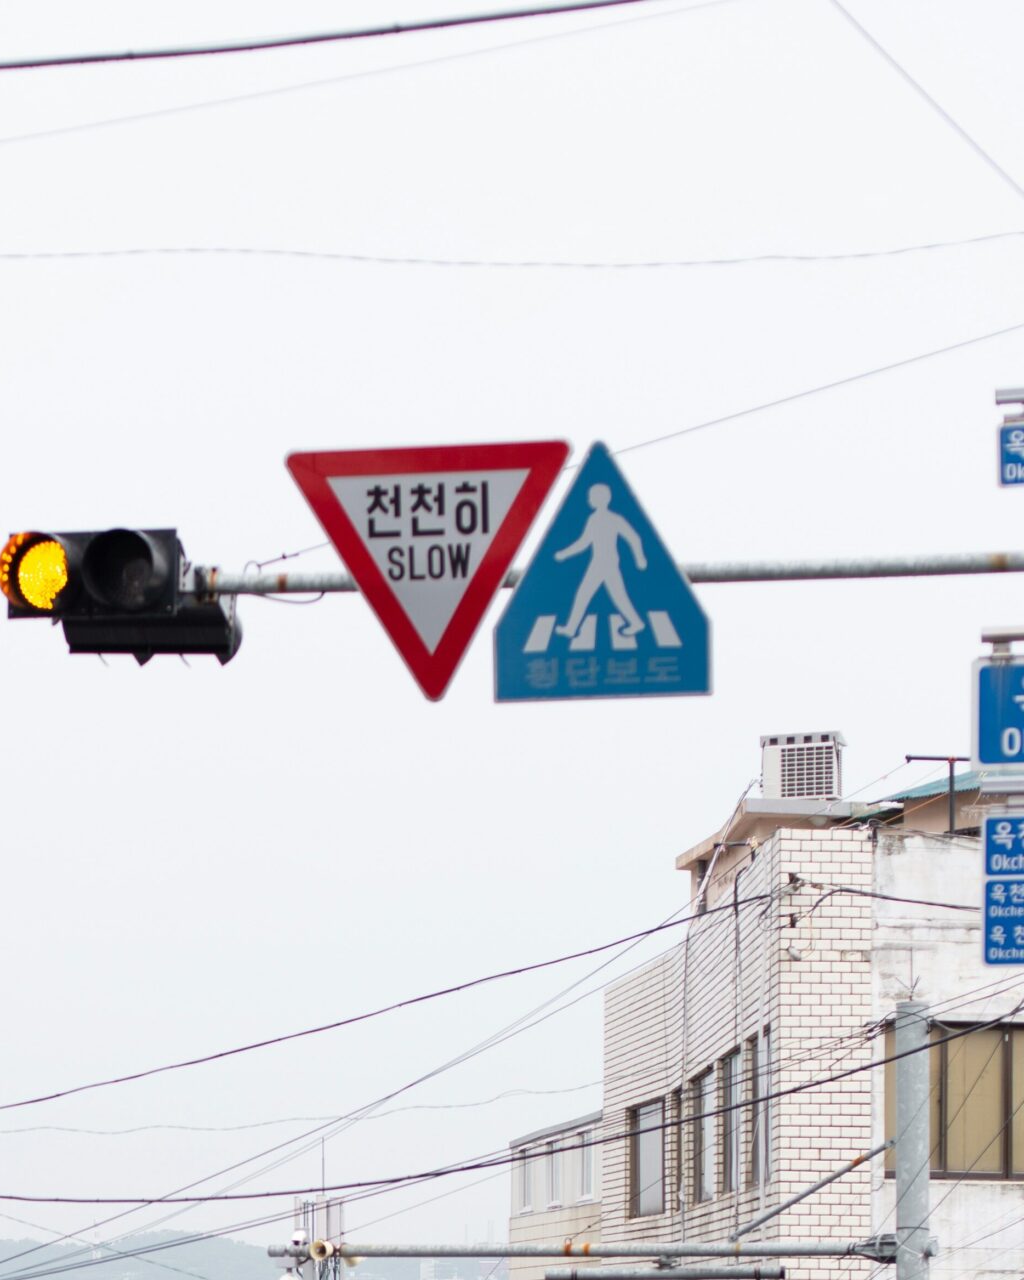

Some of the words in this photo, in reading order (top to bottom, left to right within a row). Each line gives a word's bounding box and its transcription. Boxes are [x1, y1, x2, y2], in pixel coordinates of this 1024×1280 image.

[366, 481, 490, 539] 천천히
[387, 543, 472, 582] SLOW
[524, 656, 682, 690] 횡단보도
